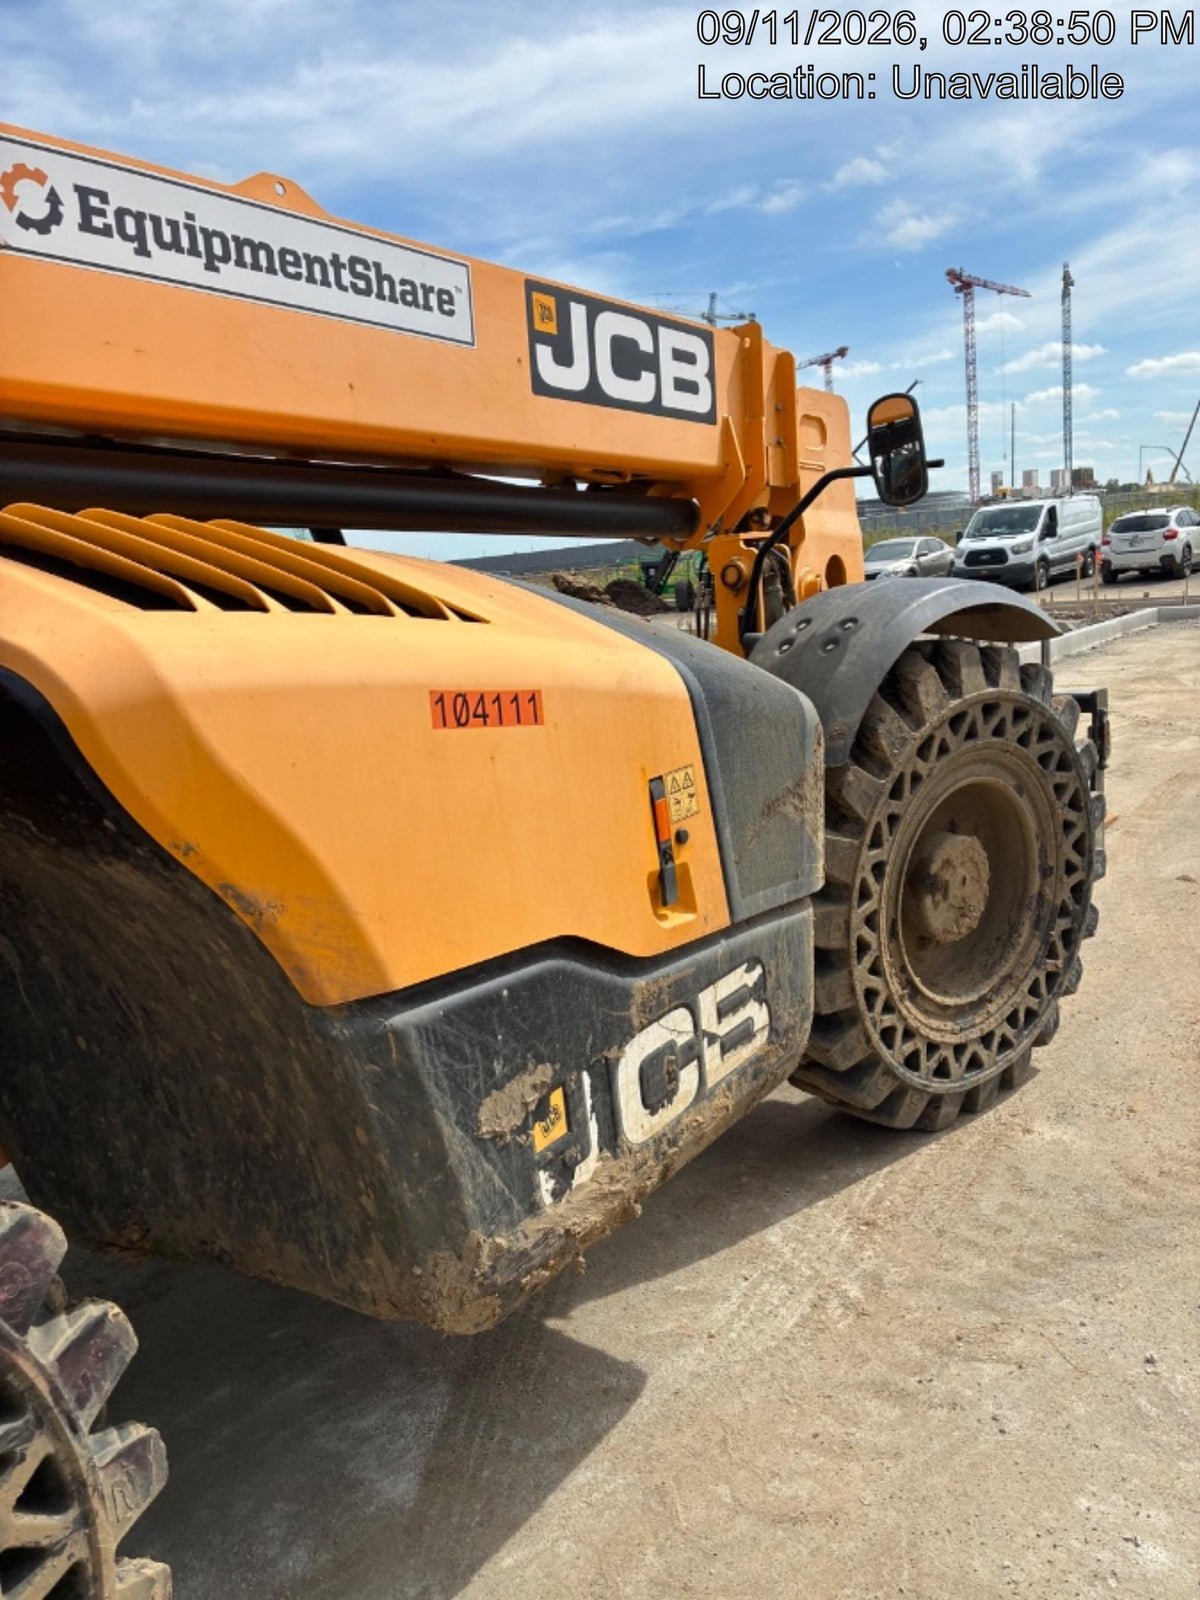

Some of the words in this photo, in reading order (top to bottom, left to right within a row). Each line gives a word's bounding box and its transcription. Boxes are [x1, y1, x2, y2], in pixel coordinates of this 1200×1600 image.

[73, 183, 456, 317] EquipmentShare
[535, 301, 712, 413] JCB
[434, 692, 538, 728] 104111
